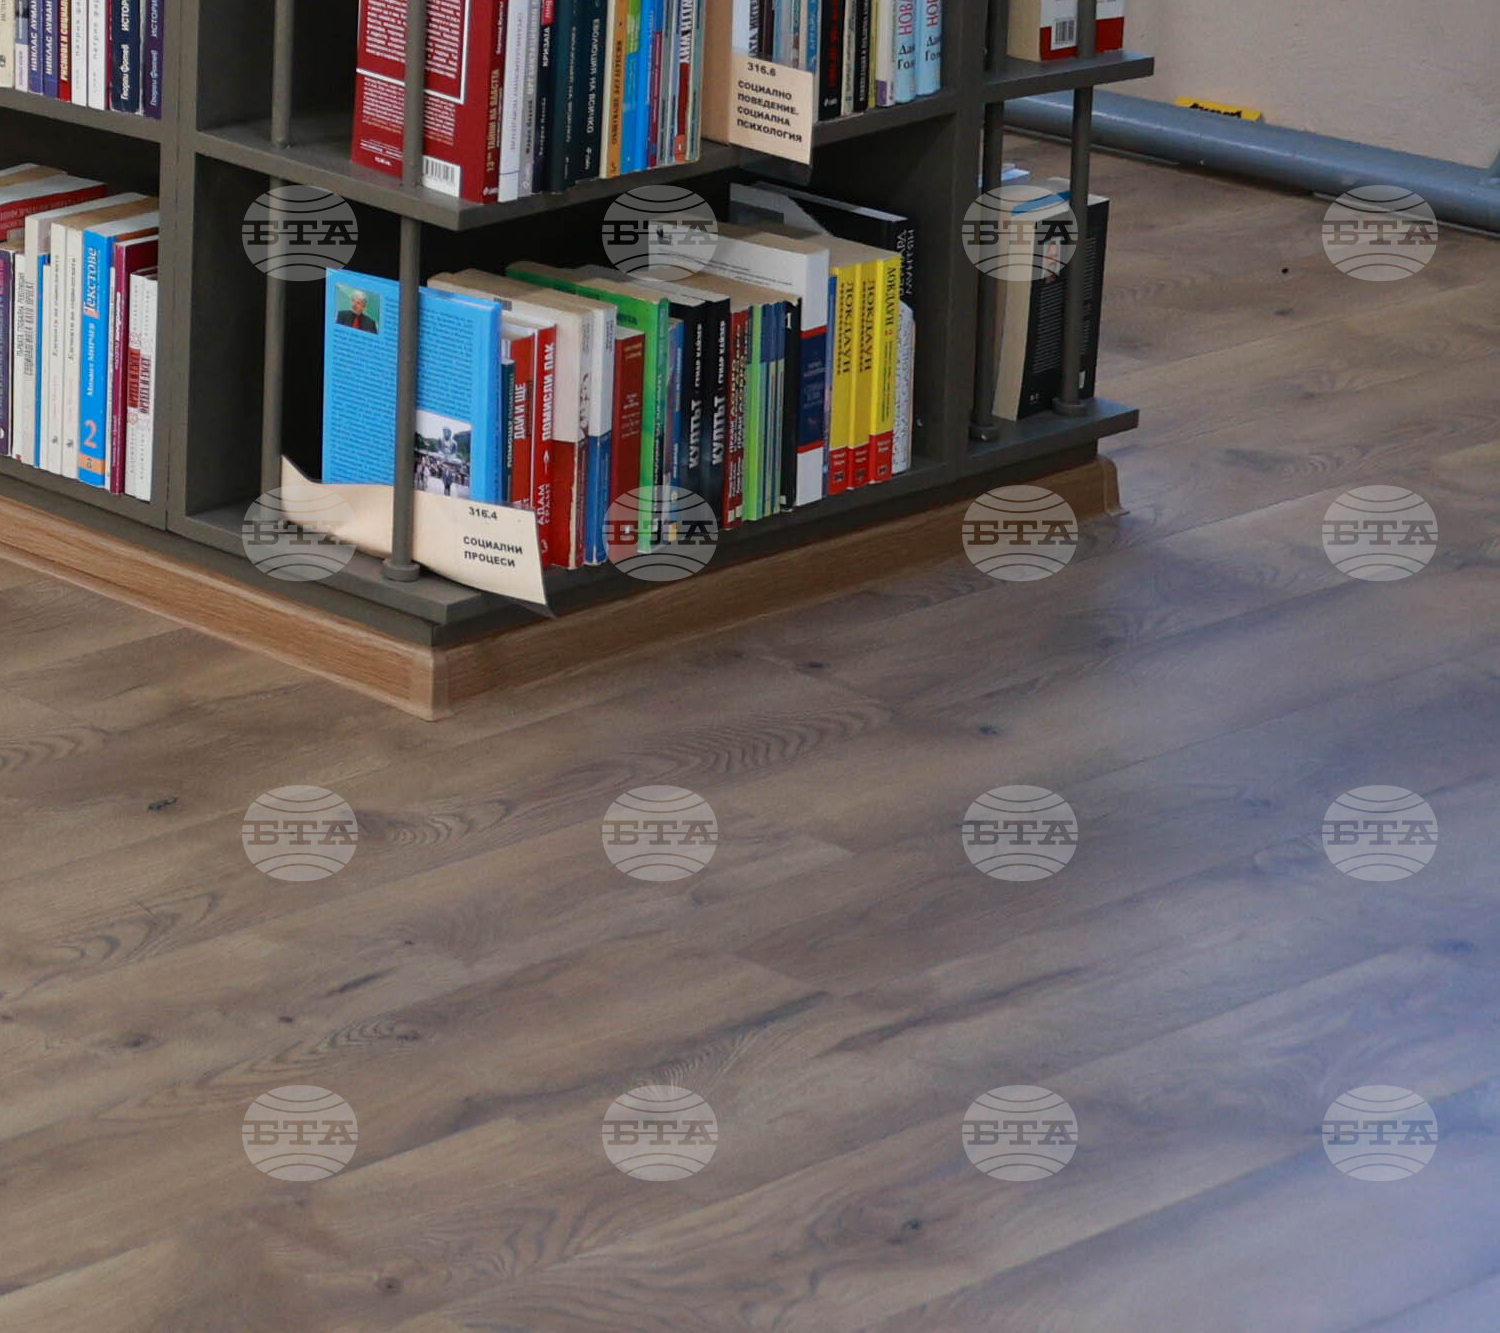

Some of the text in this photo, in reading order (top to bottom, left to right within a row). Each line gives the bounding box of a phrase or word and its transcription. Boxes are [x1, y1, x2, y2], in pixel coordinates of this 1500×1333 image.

[678, 32, 694, 64] WHY
[747, 62, 777, 77] 316.6
[737, 80, 793, 101] СОЦИАЛНО
[737, 93, 800, 115] ПОВЕДЕНИЕ.
[736, 106, 791, 126] СОЦИАЛНА
[736, 118, 803, 143] ПСИХОЛОГИЯ
[81, 247, 99, 316] Текстове
[861, 279, 877, 372] ЛОКДАУН
[540, 342, 556, 441] ПОМИСЛИ ПАК
[469, 507, 498, 520] 316.4
[463, 536, 523, 555] СОЦИАЛНИ
[464, 550, 516, 568] ПРОЦЕСИ
